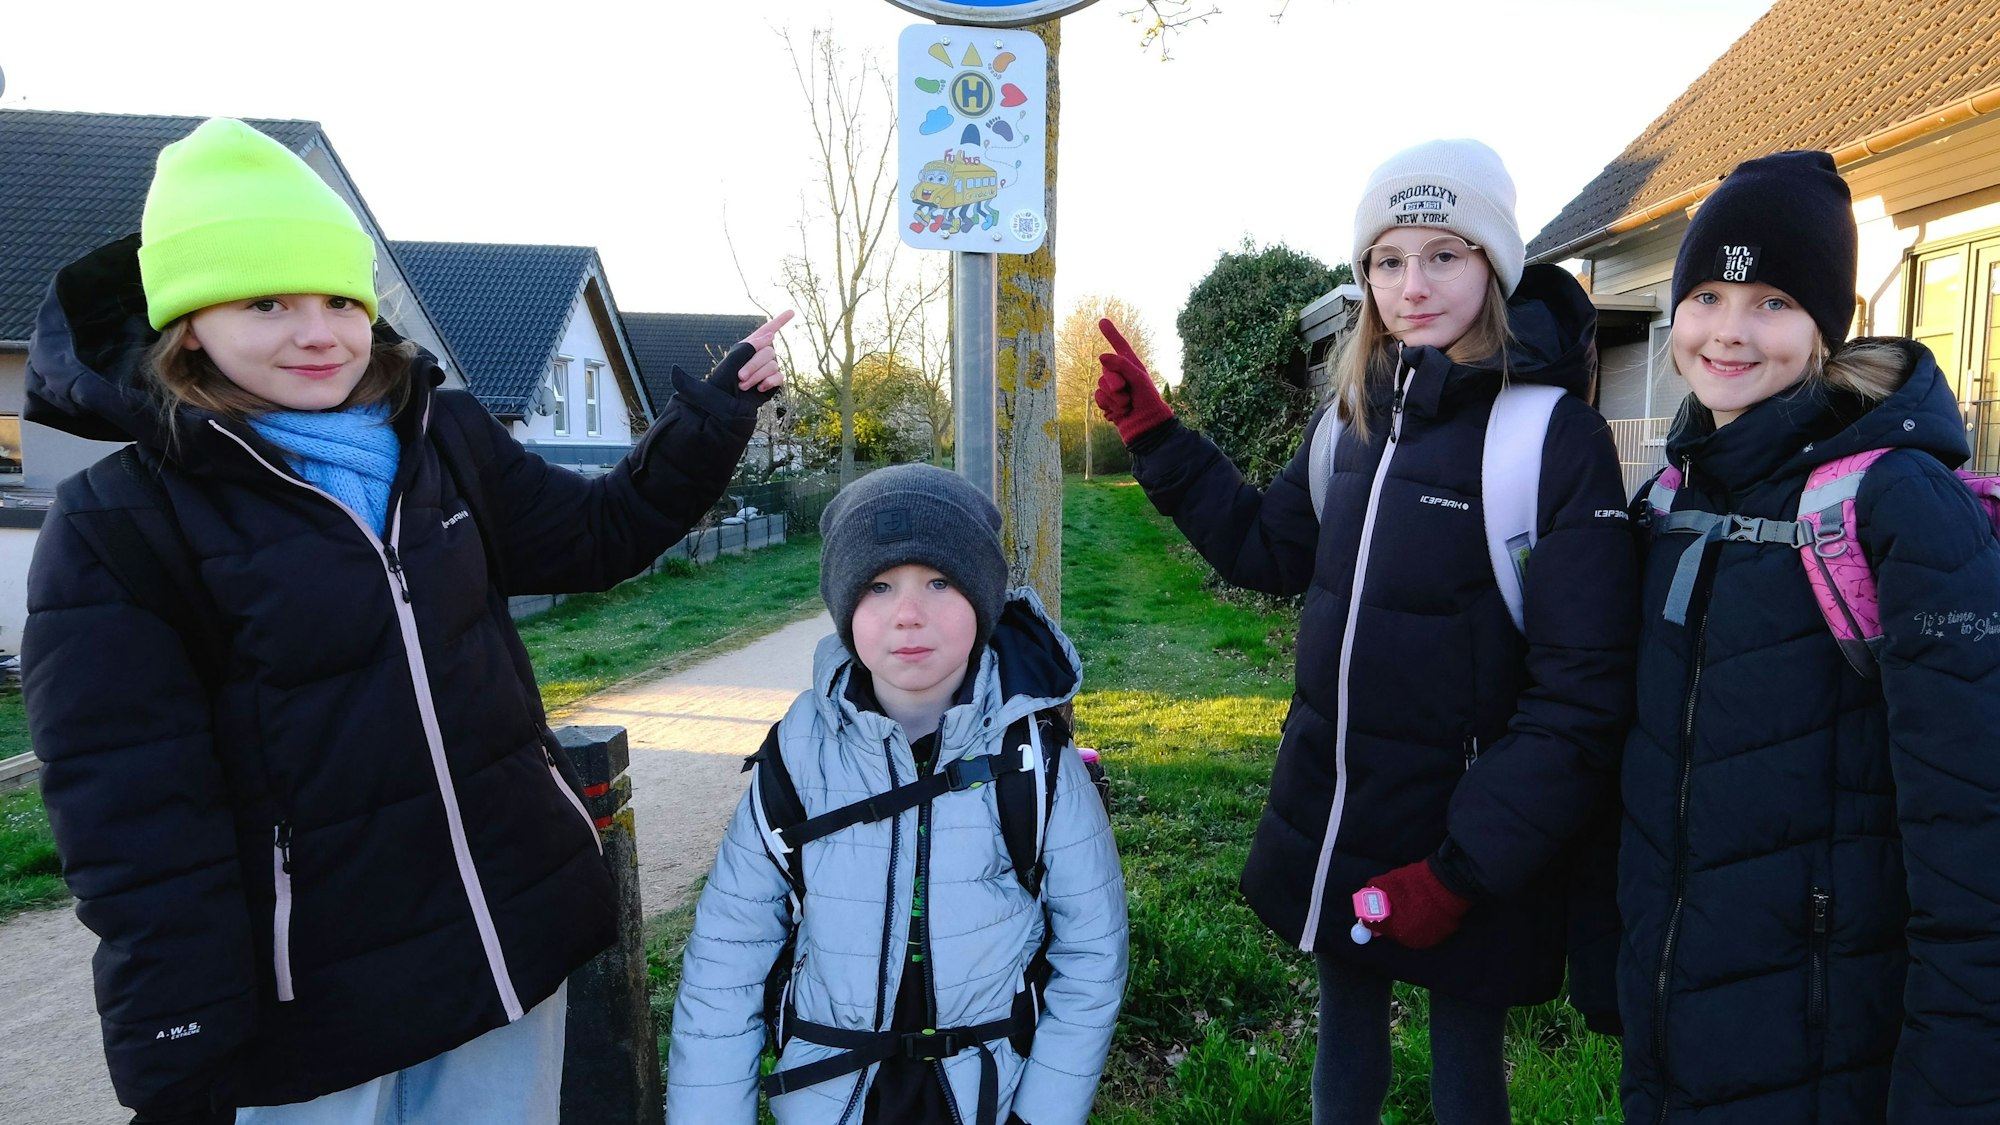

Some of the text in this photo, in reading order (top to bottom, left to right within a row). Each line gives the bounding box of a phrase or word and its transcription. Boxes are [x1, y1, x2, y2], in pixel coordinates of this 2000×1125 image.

[962, 79, 984, 108] H
[1389, 184, 1458, 208] BROOKLYN
[1396, 213, 1449, 224] NEW YORK
[1420, 495, 1463, 510] ICEPEAK
[1947, 610, 1976, 624] time
[1961, 617, 2000, 642] to Shin
[156, 1022, 201, 1039] A.W.S.
